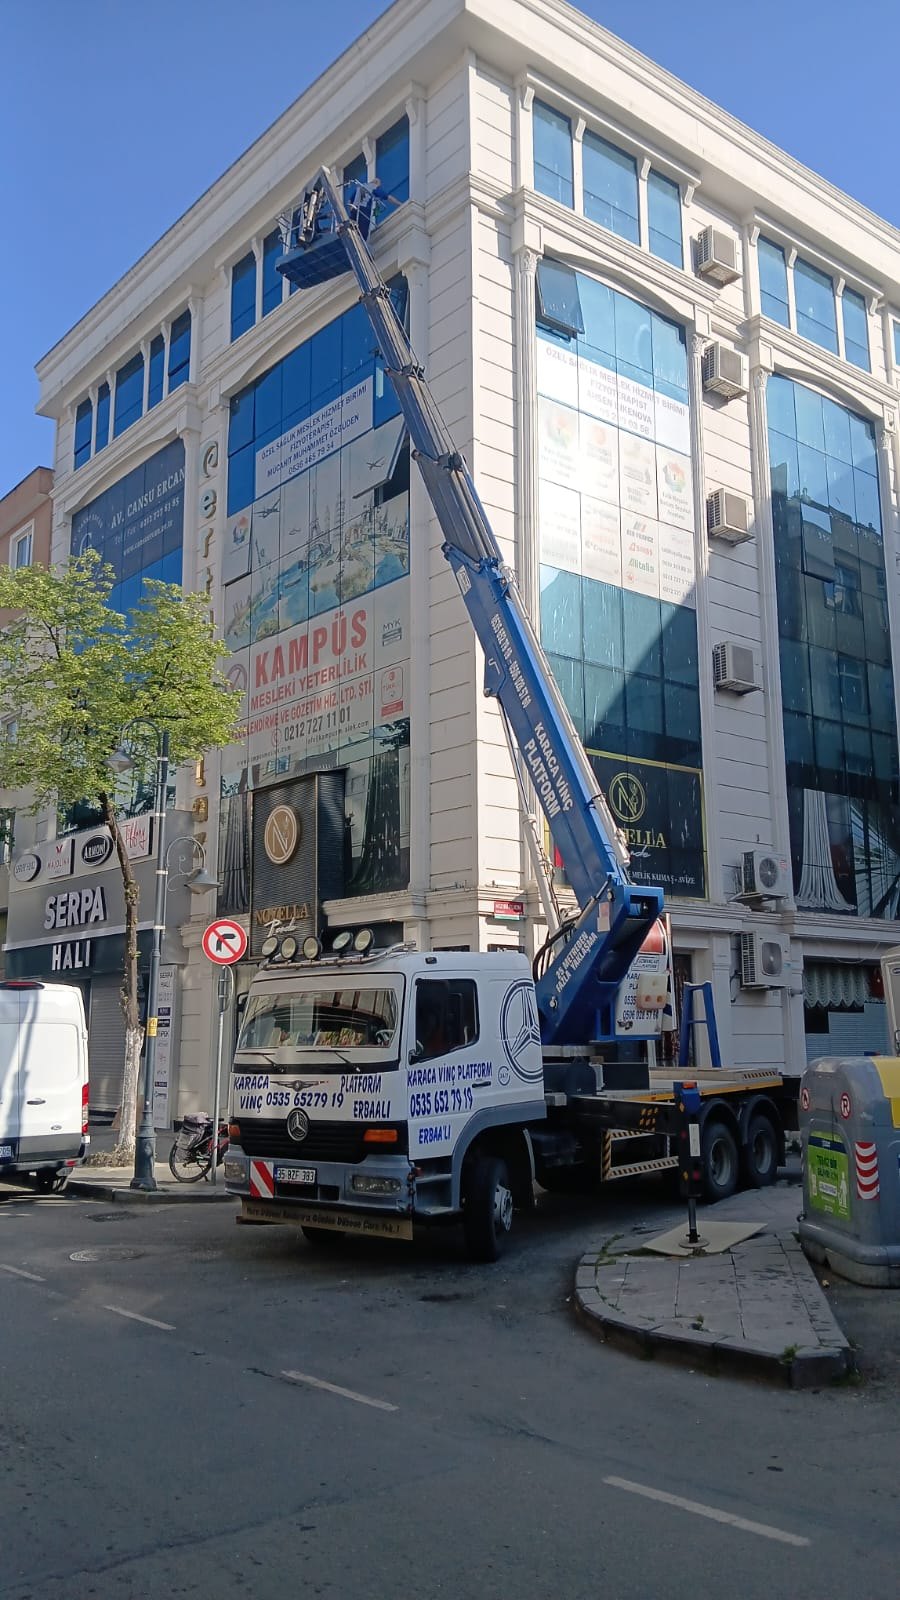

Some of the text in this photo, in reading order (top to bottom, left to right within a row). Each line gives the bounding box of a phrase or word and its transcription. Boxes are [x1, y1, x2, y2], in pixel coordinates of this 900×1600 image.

[110, 468, 185, 529] AV. CANSU ERCAN
[256, 610, 366, 688] KAMPÜS
[252, 653, 366, 711] MESLEKİ YETERLİLİK
[280, 710, 290, 724] VE
[284, 706, 350, 742] 0212 727 11 01
[524, 738, 561, 818] PLATFORM
[534, 722, 574, 811] KARACA VİNÇ
[44, 886, 105, 930] SERPA
[256, 903, 310, 925] NOVELLA
[52, 940, 91, 971] HALI
[556, 970, 572, 994] FAZLA
[234, 1076, 382, 1093] KARACA PLATFORM
[408, 1062, 492, 1088] KARACA VİNÇ PLATFORM
[240, 1092, 262, 1114] VİNÇ
[266, 1092, 290, 1106] 0535
[331, 1092, 344, 1108] 19
[354, 1100, 390, 1118] ERBAALI
[410, 1087, 474, 1118] 0535 652 79 19
[278, 1169, 286, 1179] 35
[288, 1170, 300, 1180] BZF
